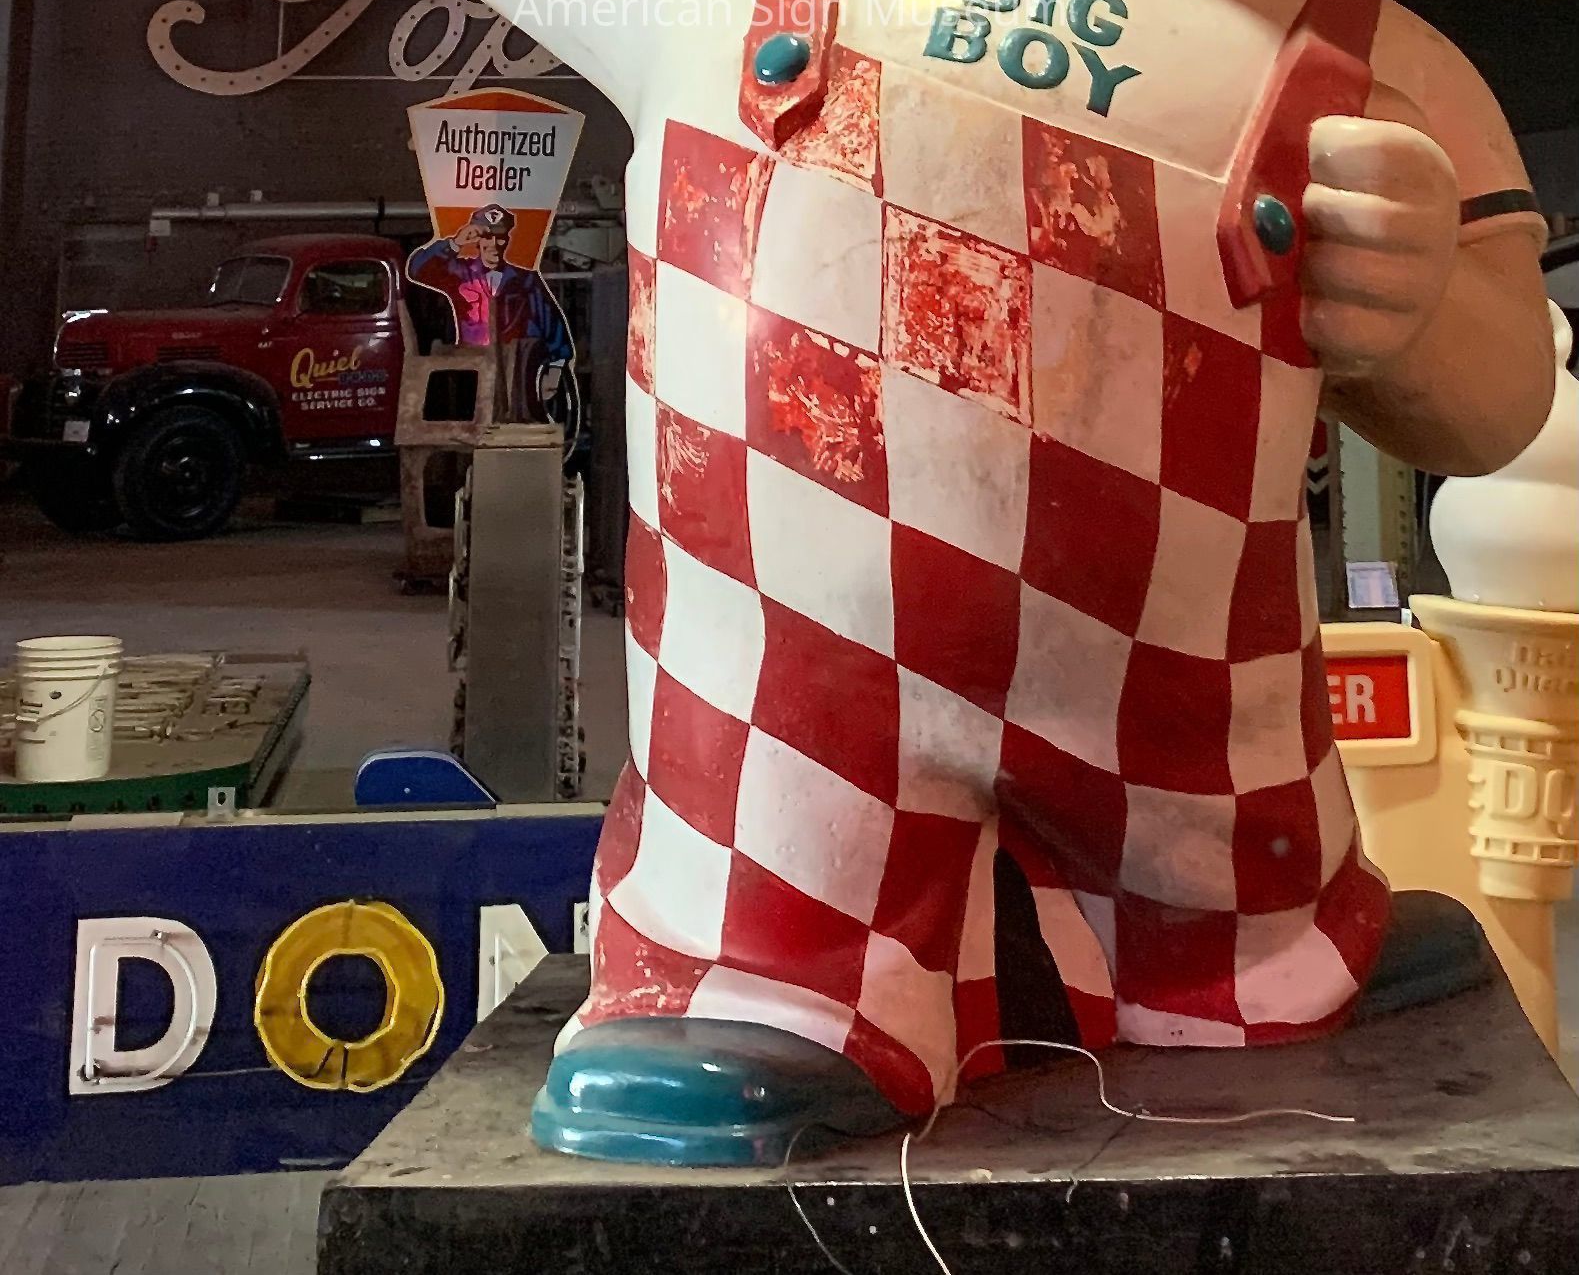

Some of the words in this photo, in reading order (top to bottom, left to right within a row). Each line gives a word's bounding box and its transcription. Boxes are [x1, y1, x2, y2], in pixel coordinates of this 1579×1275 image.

[923, 7, 1142, 116] BOY
[435, 120, 556, 157] Authorized
[456, 156, 531, 191] Dealer
[292, 389, 352, 402] ELECTRIC
[357, 387, 386, 398] SIGN
[301, 399, 353, 411] SERVICE
